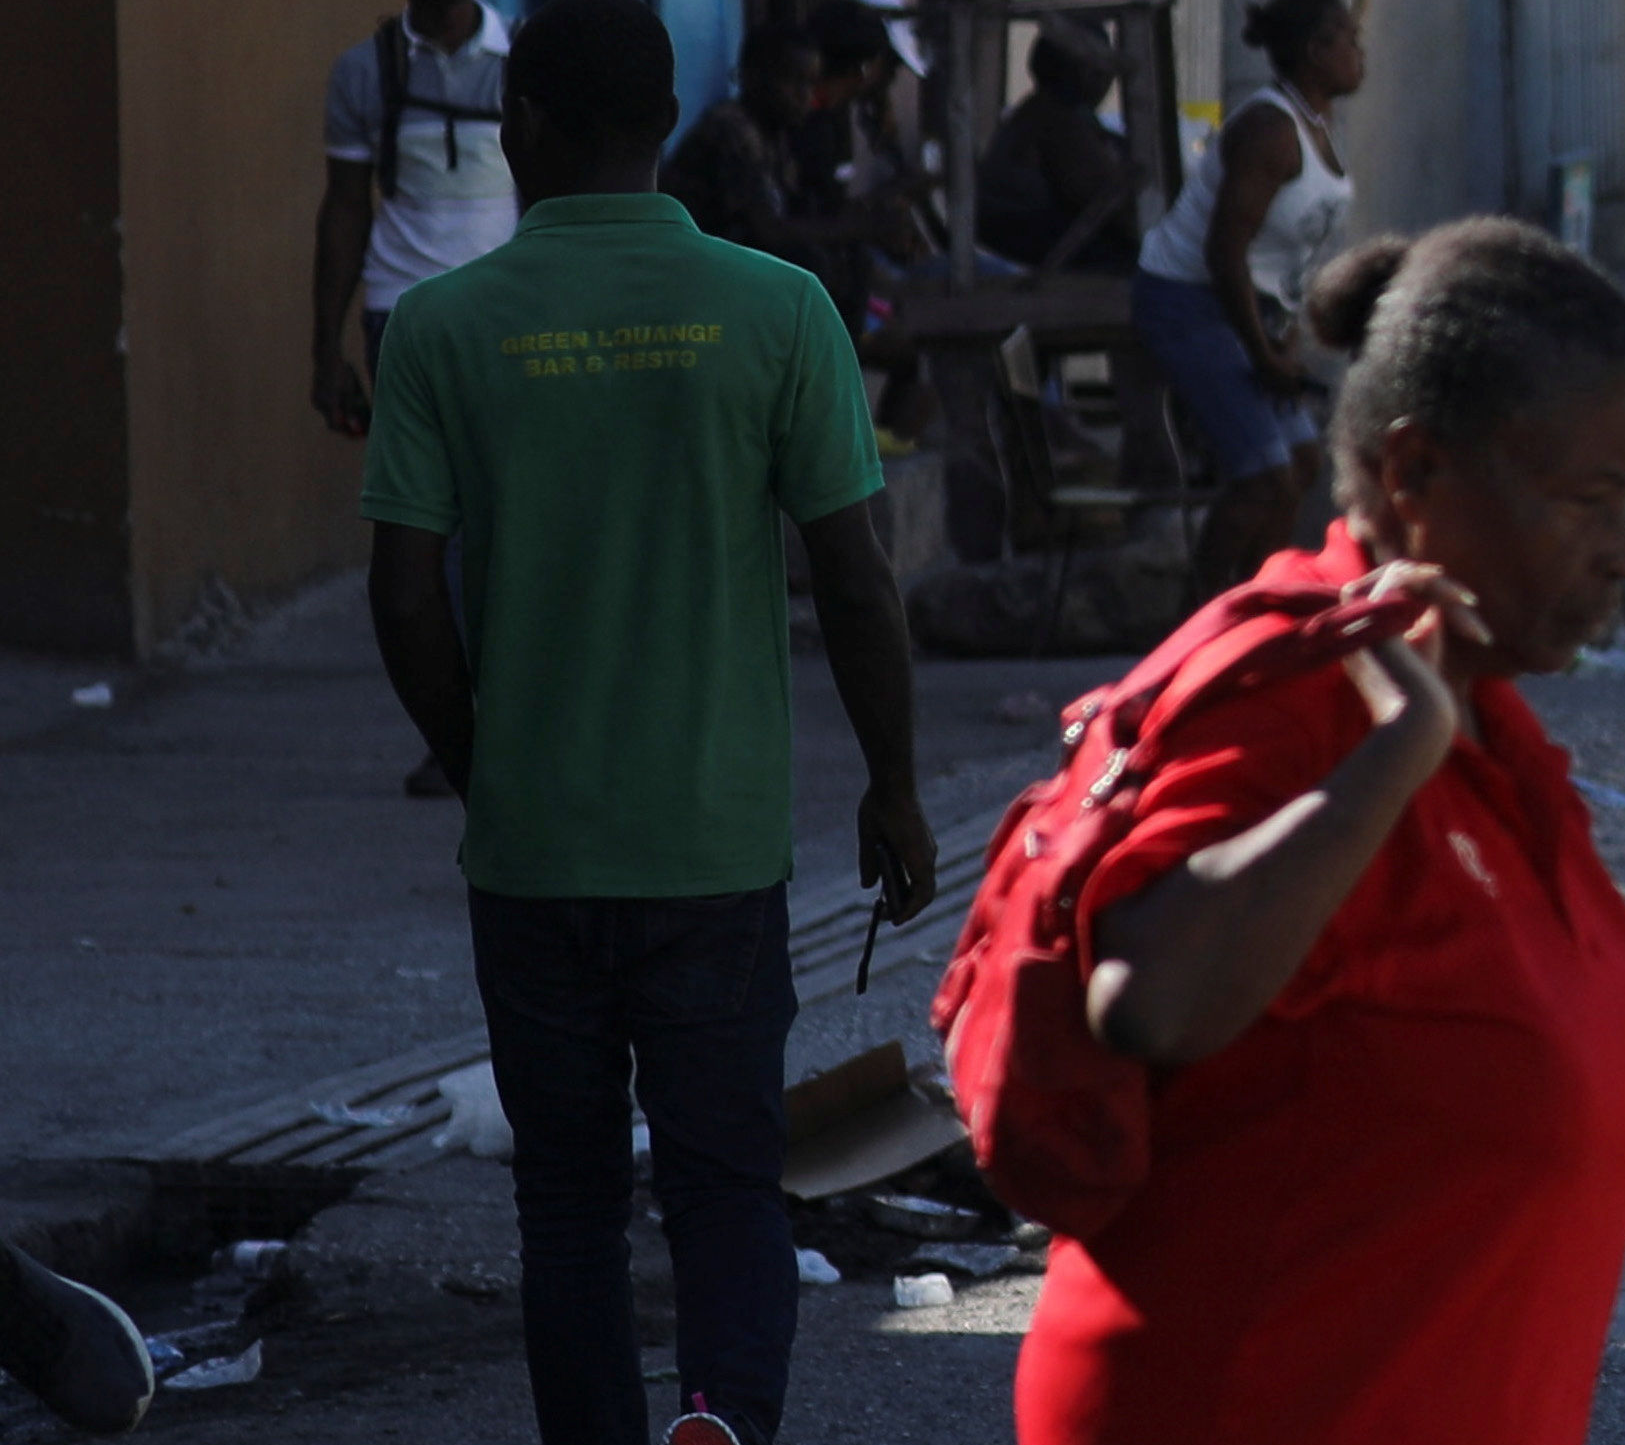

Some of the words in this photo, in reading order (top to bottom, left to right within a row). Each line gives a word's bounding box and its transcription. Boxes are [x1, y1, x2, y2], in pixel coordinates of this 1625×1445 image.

[500, 329, 589, 355] GREEN
[597, 324, 723, 347] LOUANGE
[525, 357, 577, 378] BAR
[585, 354, 605, 374] &
[613, 349, 699, 372] RESTO
